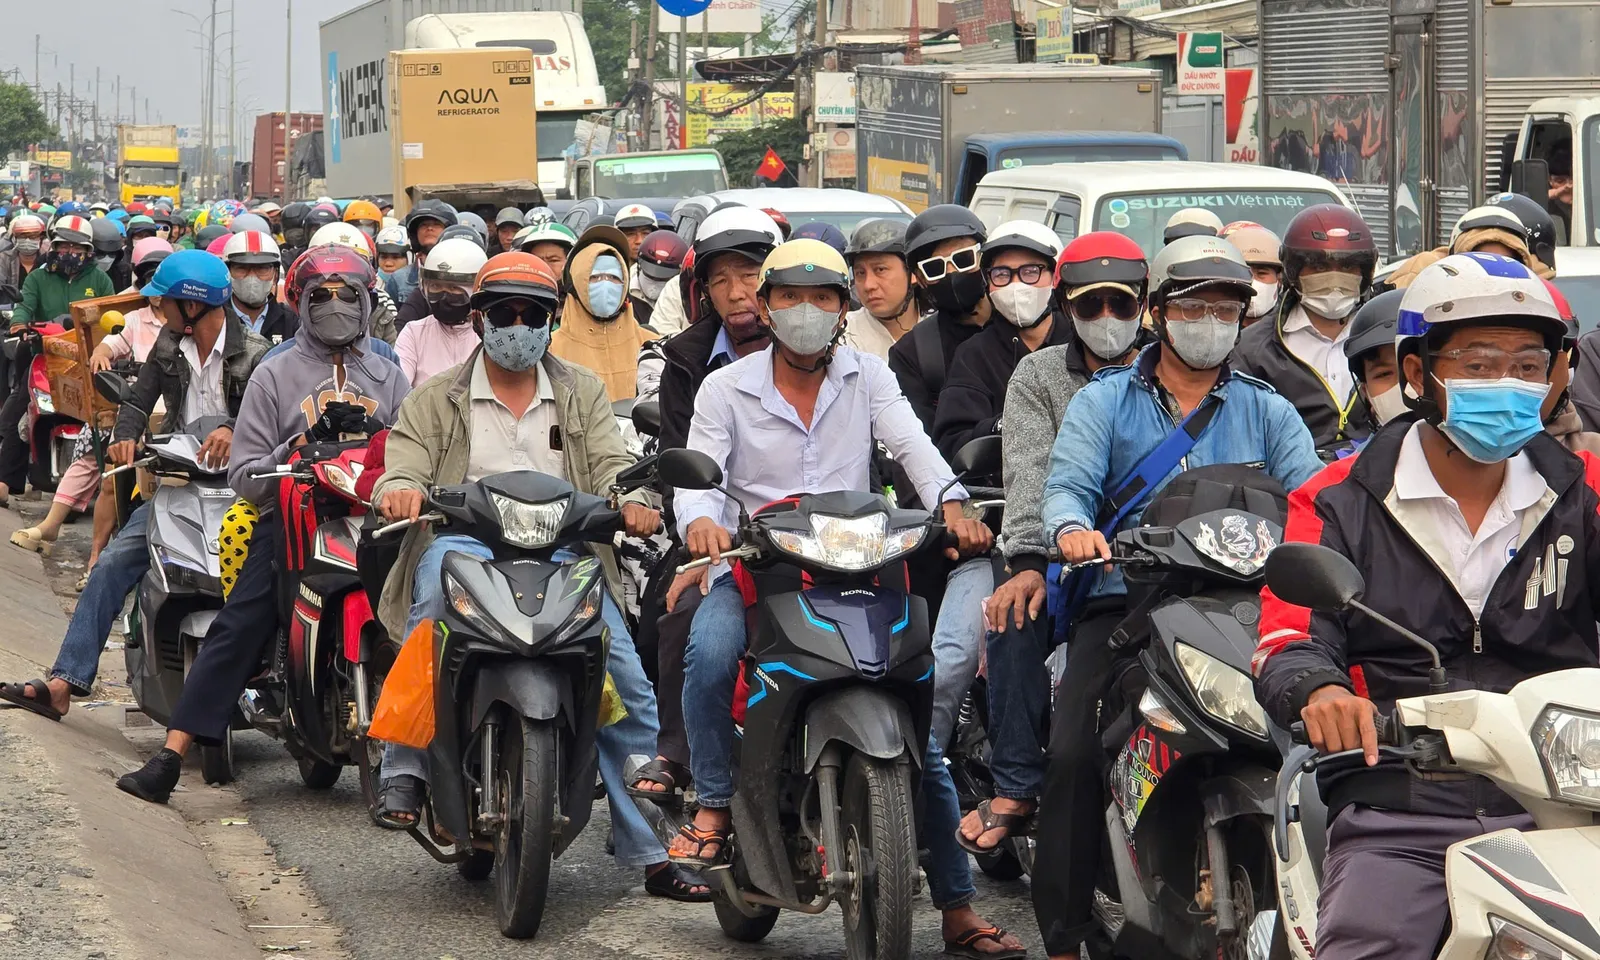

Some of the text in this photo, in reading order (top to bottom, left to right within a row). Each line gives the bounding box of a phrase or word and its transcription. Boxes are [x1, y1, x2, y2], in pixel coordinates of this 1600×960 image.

[340, 58, 387, 139] MAERSK
[438, 88, 499, 104] AQUA
[438, 108, 500, 116] REFRIGERATOR
[1130, 196, 1224, 210] SUZUKI
[181, 289, 198, 297] Within
[300, 582, 322, 608] YAMAHA
[840, 589, 876, 597] HONDA
[756, 667, 780, 692] HONDA
[1131, 757, 1159, 786] NOUVO
[1294, 926, 1316, 960] SIR
